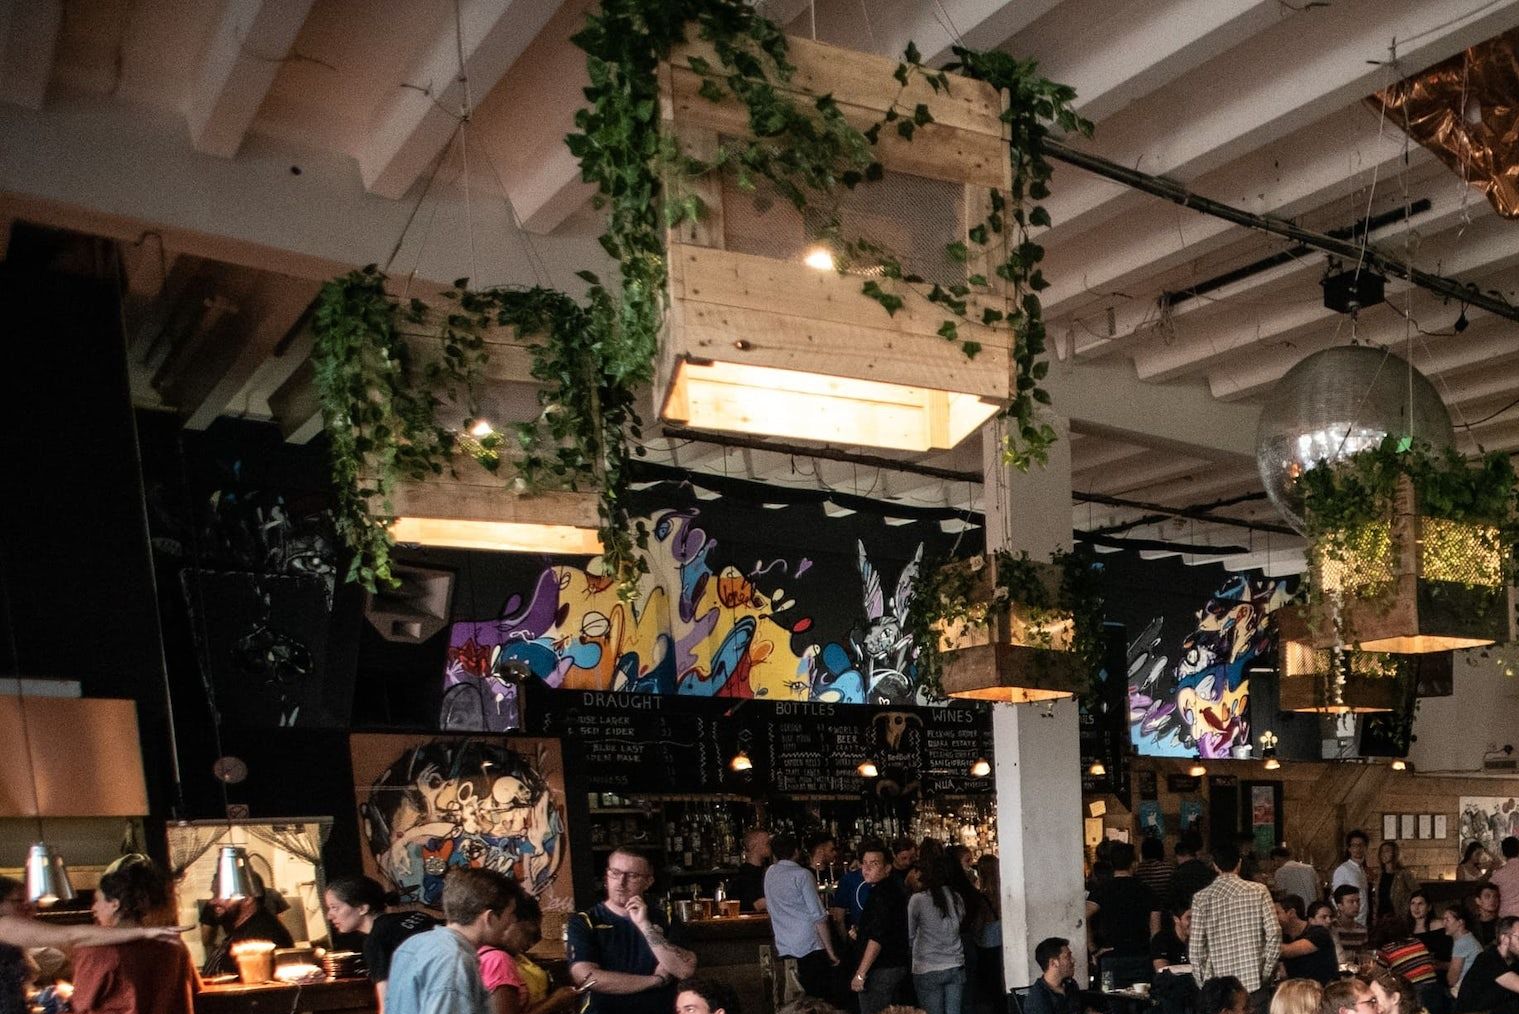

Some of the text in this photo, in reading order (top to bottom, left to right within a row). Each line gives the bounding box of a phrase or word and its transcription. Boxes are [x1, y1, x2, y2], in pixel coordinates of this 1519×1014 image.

[583, 692, 664, 710] DRAUGHT
[775, 702, 836, 717] BOTTLES
[932, 709, 974, 724] WINES
[836, 734, 858, 744] BEER
